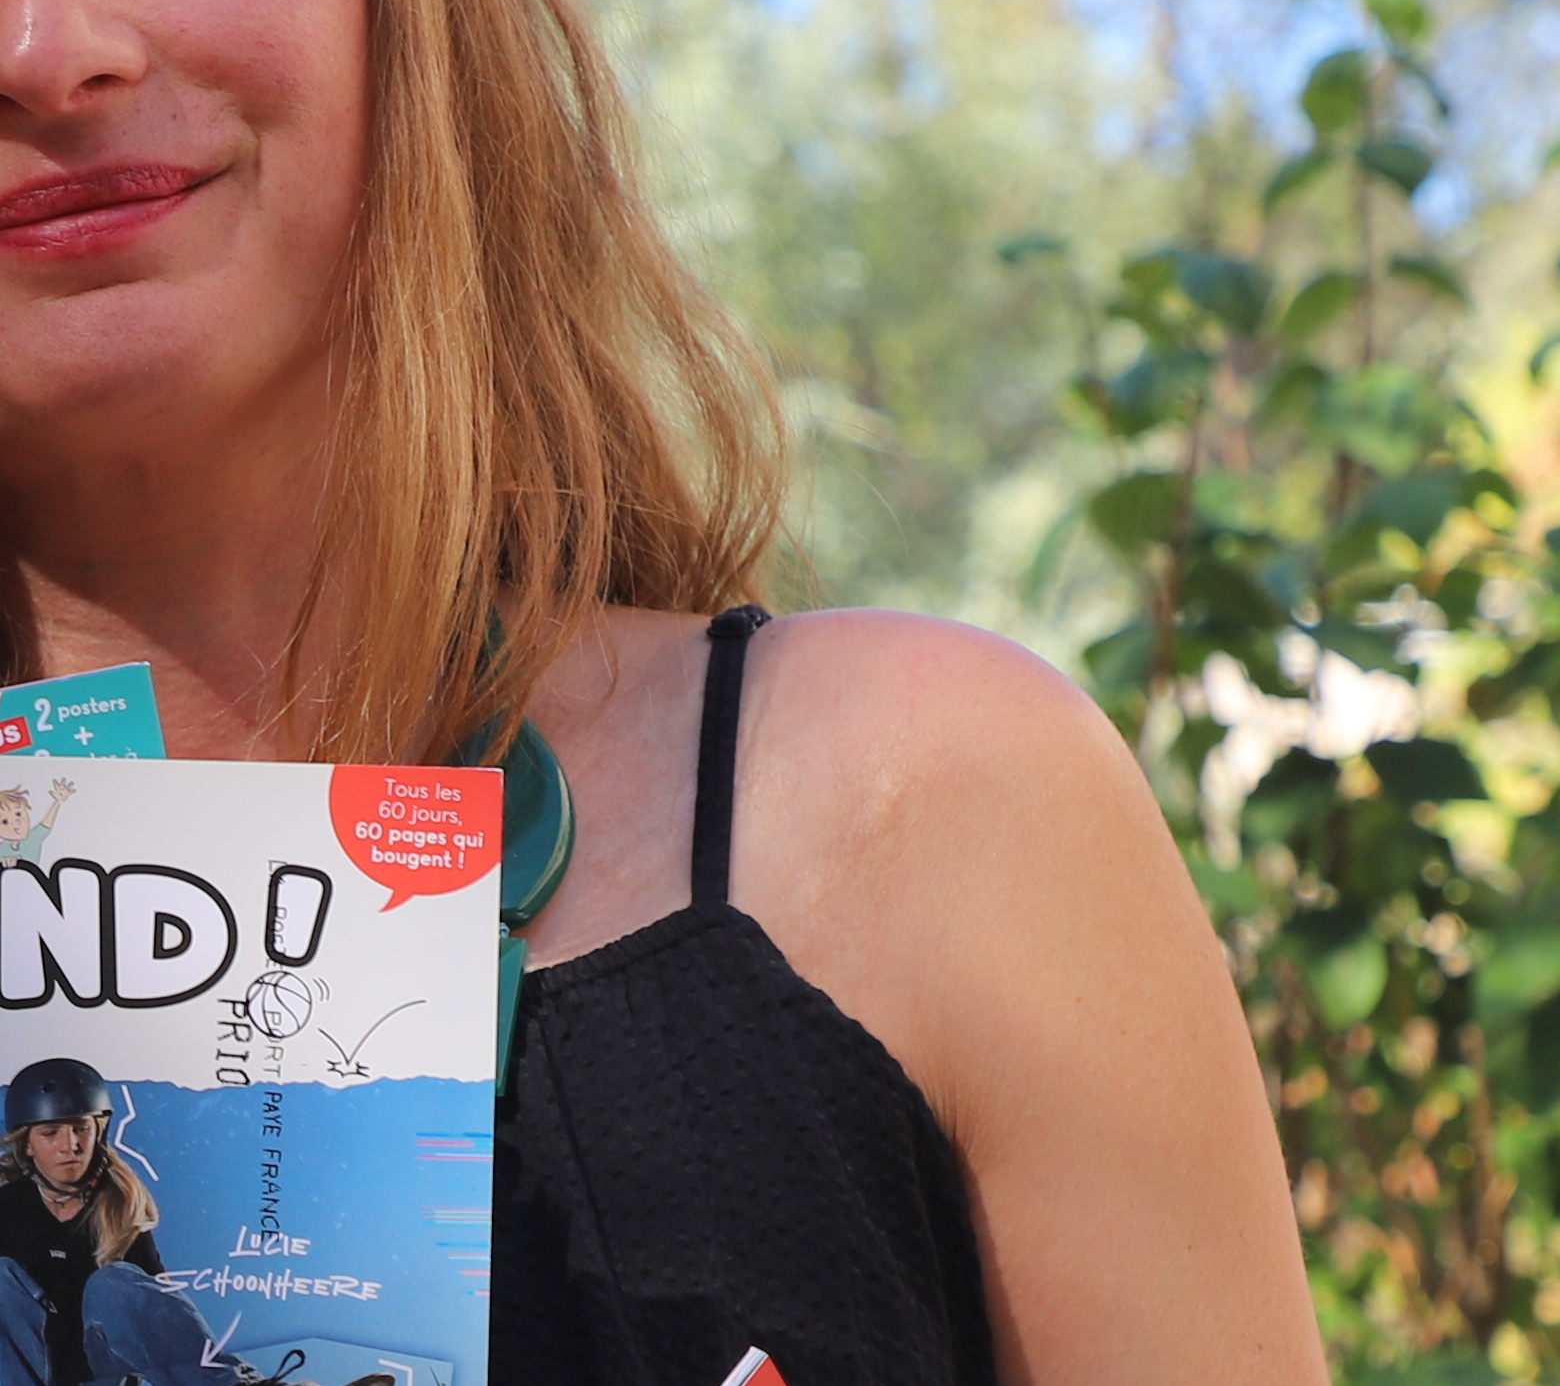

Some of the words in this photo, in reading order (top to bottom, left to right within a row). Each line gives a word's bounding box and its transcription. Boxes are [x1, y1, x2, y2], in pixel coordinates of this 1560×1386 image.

[33, 697, 54, 732] 2
[57, 696, 127, 722] posters
[383, 777, 429, 800] Tous
[435, 782, 462, 802] les
[379, 801, 406, 820] 60
[408, 803, 463, 827] jours,
[355, 821, 383, 840] 60
[387, 827, 447, 848] pages
[453, 831, 484, 849] qui
[370, 846, 452, 870] bougent
[457, 852, 465, 869] !
[216, 999, 253, 1086] PRIO
[262, 1091, 283, 1136] PAYE
[260, 1147, 282, 1243] FRANCE
[154, 1264, 381, 1302] SCHOONHEERE
